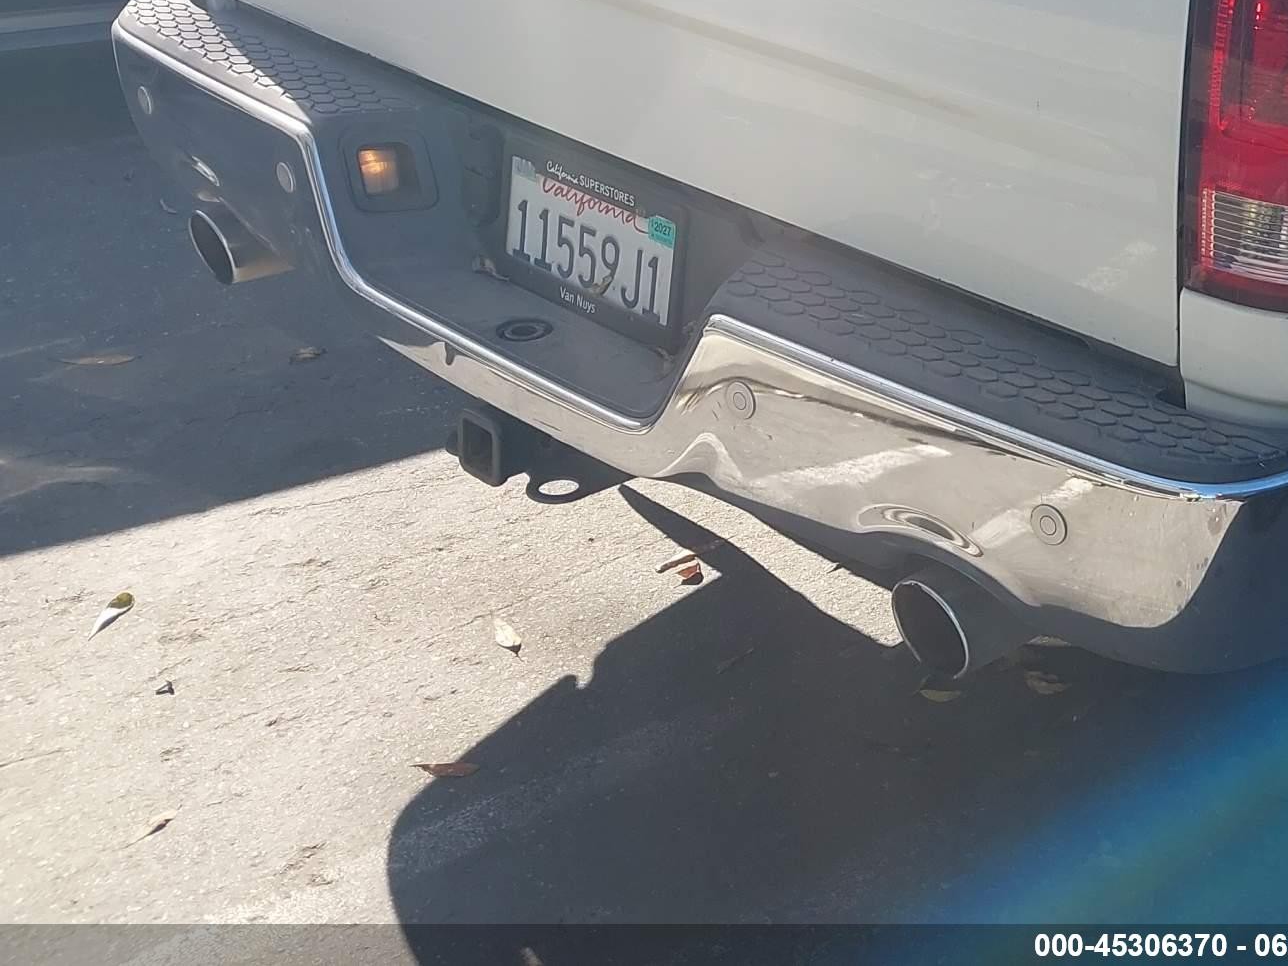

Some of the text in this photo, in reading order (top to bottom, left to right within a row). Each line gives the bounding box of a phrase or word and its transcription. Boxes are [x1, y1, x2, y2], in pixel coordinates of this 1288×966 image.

[546, 160, 579, 184] California
[579, 175, 636, 207] SUPERSTORES
[654, 221, 671, 237] 2027
[559, 286, 596, 314] Van Nuys
